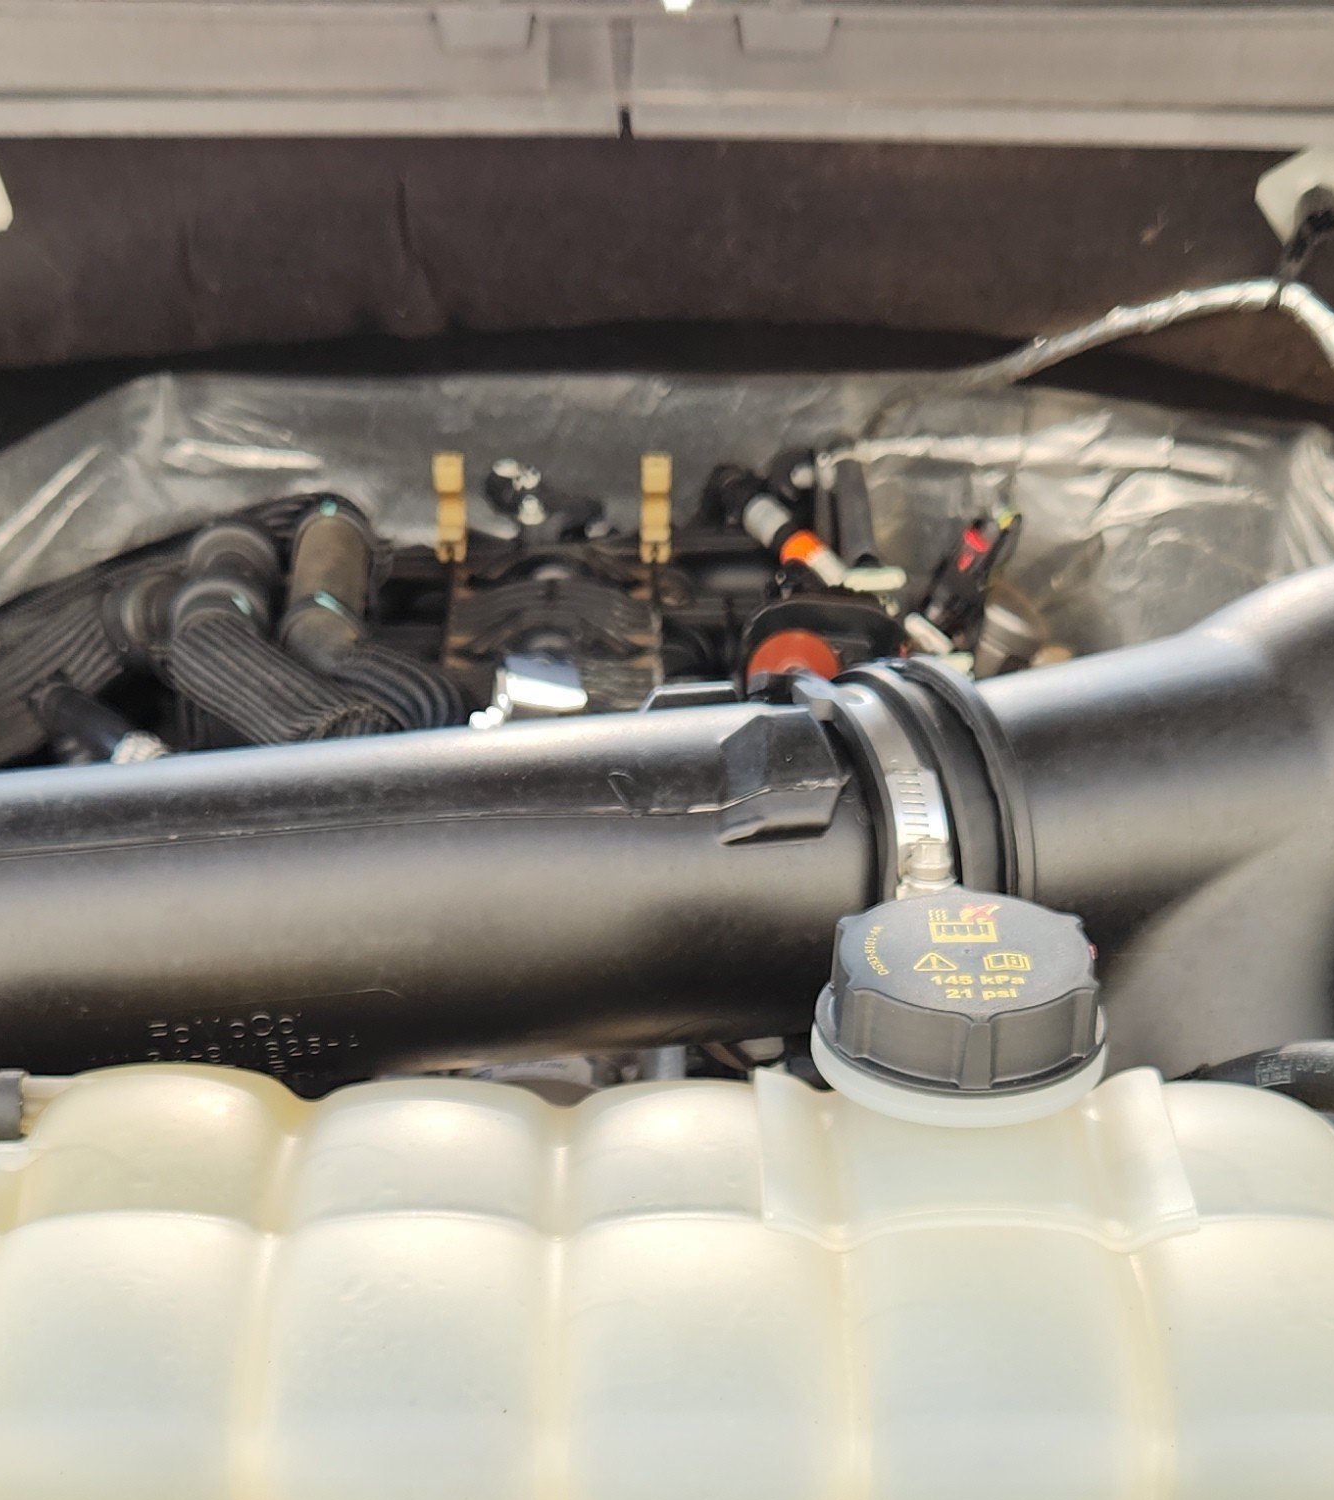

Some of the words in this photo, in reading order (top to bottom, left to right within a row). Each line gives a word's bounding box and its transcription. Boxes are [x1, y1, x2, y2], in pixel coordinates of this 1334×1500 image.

[930, 975, 973, 985] 145
[979, 975, 1025, 985] kPa
[945, 988, 973, 999] 21
[982, 988, 1018, 1000] psi
